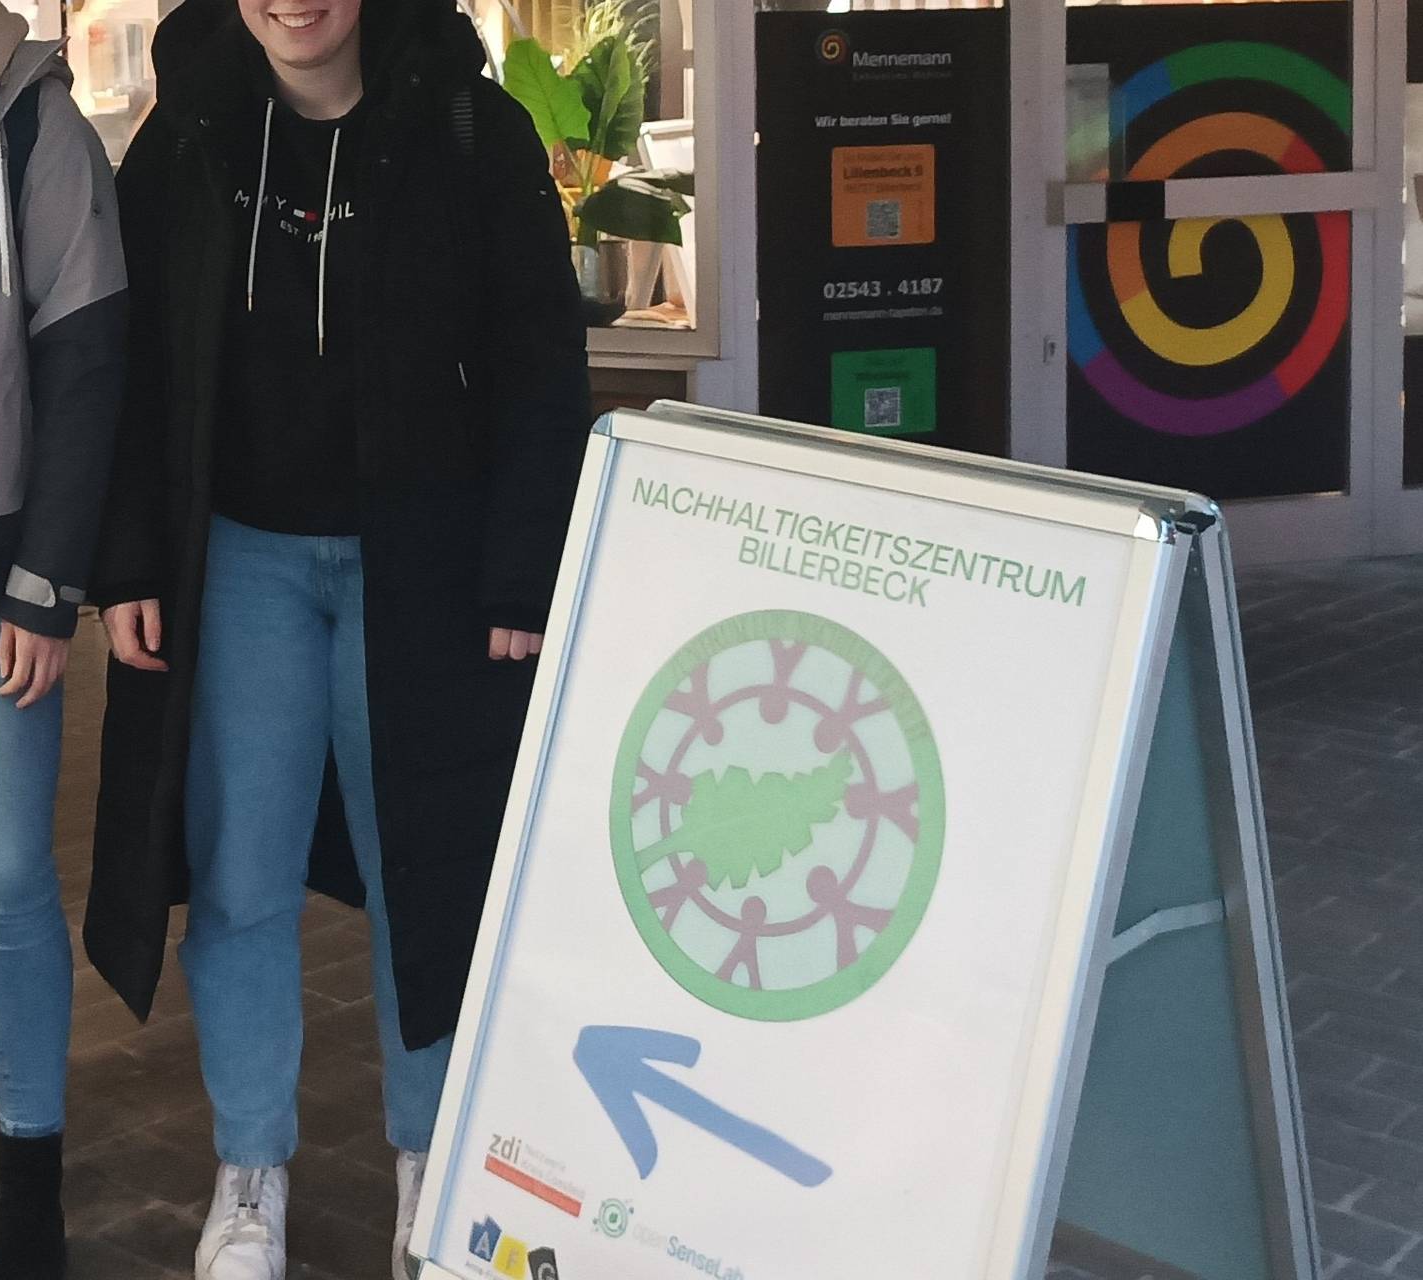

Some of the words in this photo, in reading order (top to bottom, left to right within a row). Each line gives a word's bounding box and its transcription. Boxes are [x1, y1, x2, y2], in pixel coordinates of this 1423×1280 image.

[852, 51, 952, 67] Mennemann
[815, 115, 837, 127] Wir
[840, 115, 888, 127] beraten
[891, 112, 910, 125] Sie
[823, 280, 881, 299] 02543
[897, 277, 944, 296] 4187
[631, 475, 1088, 607] NACHHALTIGKEITSZENTRUM
[738, 535, 932, 608] BILLERBECK
[488, 1133, 523, 1164] zdi
